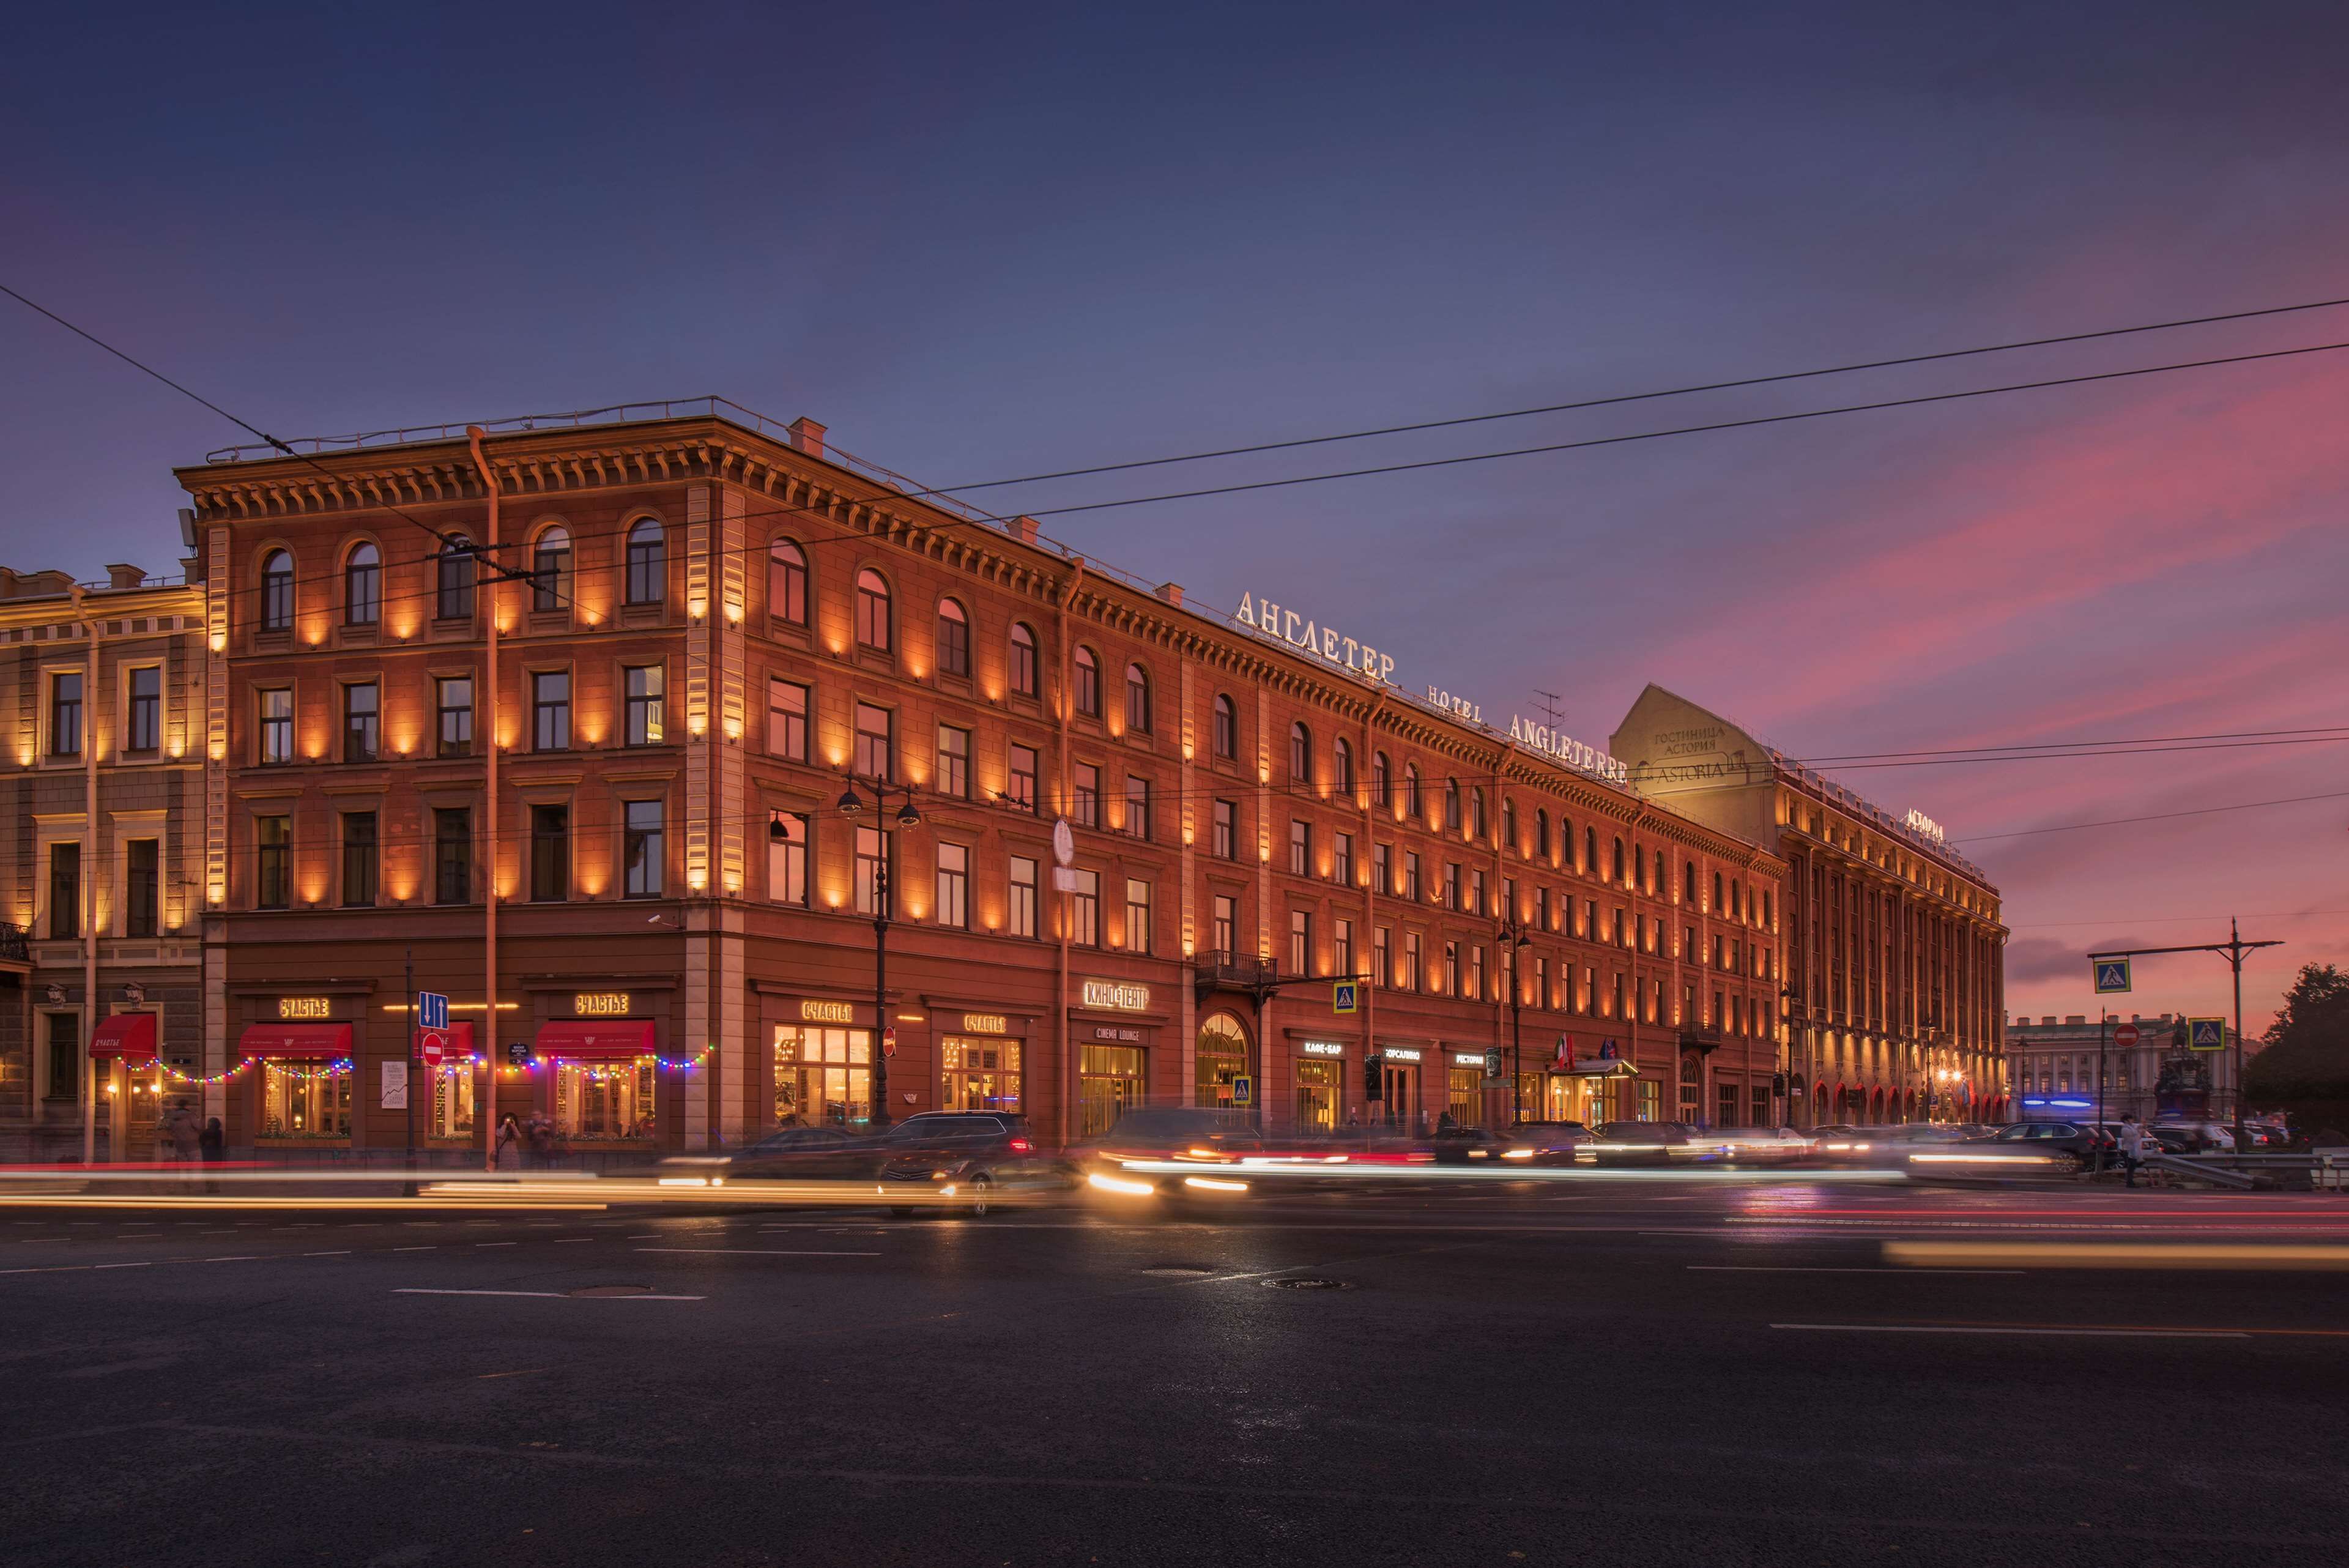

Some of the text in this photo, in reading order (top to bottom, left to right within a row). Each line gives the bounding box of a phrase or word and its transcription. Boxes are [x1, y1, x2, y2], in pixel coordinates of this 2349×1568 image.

[1236, 591, 1395, 682] АНГЛЕТЕР
[1427, 685, 1482, 723] HOTEL
[1655, 727, 1726, 745] ГОСТИНИЦА
[1510, 714, 1628, 784] ANGLETERRE
[1664, 740, 1716, 756] АСТОРИЯ
[1657, 763, 1724, 784] ASTORIA
[279, 998, 329, 1017] СЧАСТЬЕ
[576, 994, 628, 1013] СЧАСТЬЕ
[803, 1001, 853, 1022] СЧАСТЬЕ
[965, 1016, 1007, 1033] СЧАСТЬЕ
[1096, 1028, 1139, 1041] CINEMA LOUNGE
[1456, 1054, 1483, 1065] РЕСТОРАН
